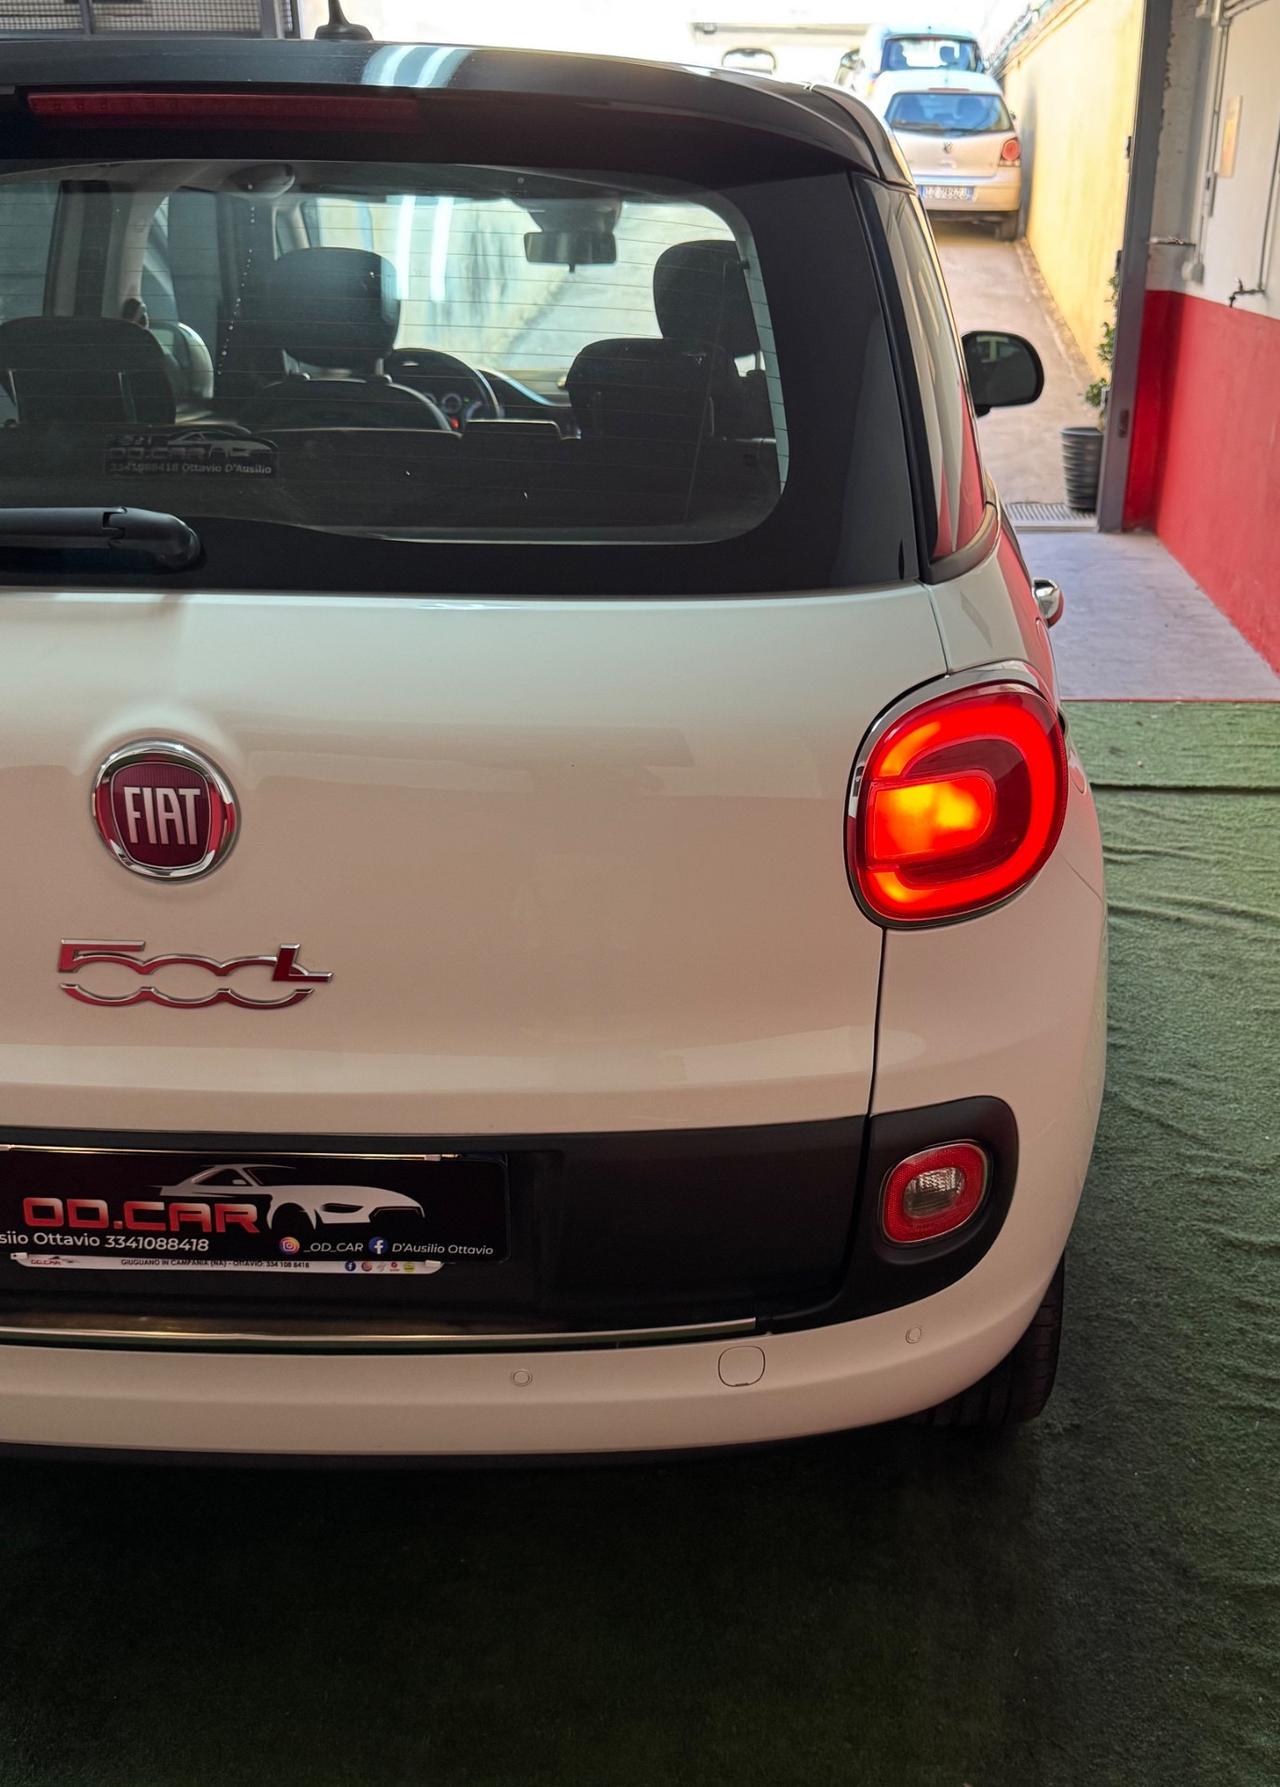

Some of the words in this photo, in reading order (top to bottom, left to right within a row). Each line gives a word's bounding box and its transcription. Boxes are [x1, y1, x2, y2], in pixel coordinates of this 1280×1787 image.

[124, 786, 201, 845] FIAT
[57, 938, 335, 1009] 500L
[23, 1197, 260, 1233] OD.CAR
[33, 1232, 101, 1246] Ottavio
[104, 1235, 209, 1251] 3341088418
[391, 1242, 445, 1254] D'Ausilio
[447, 1244, 494, 1255] Ottavio
